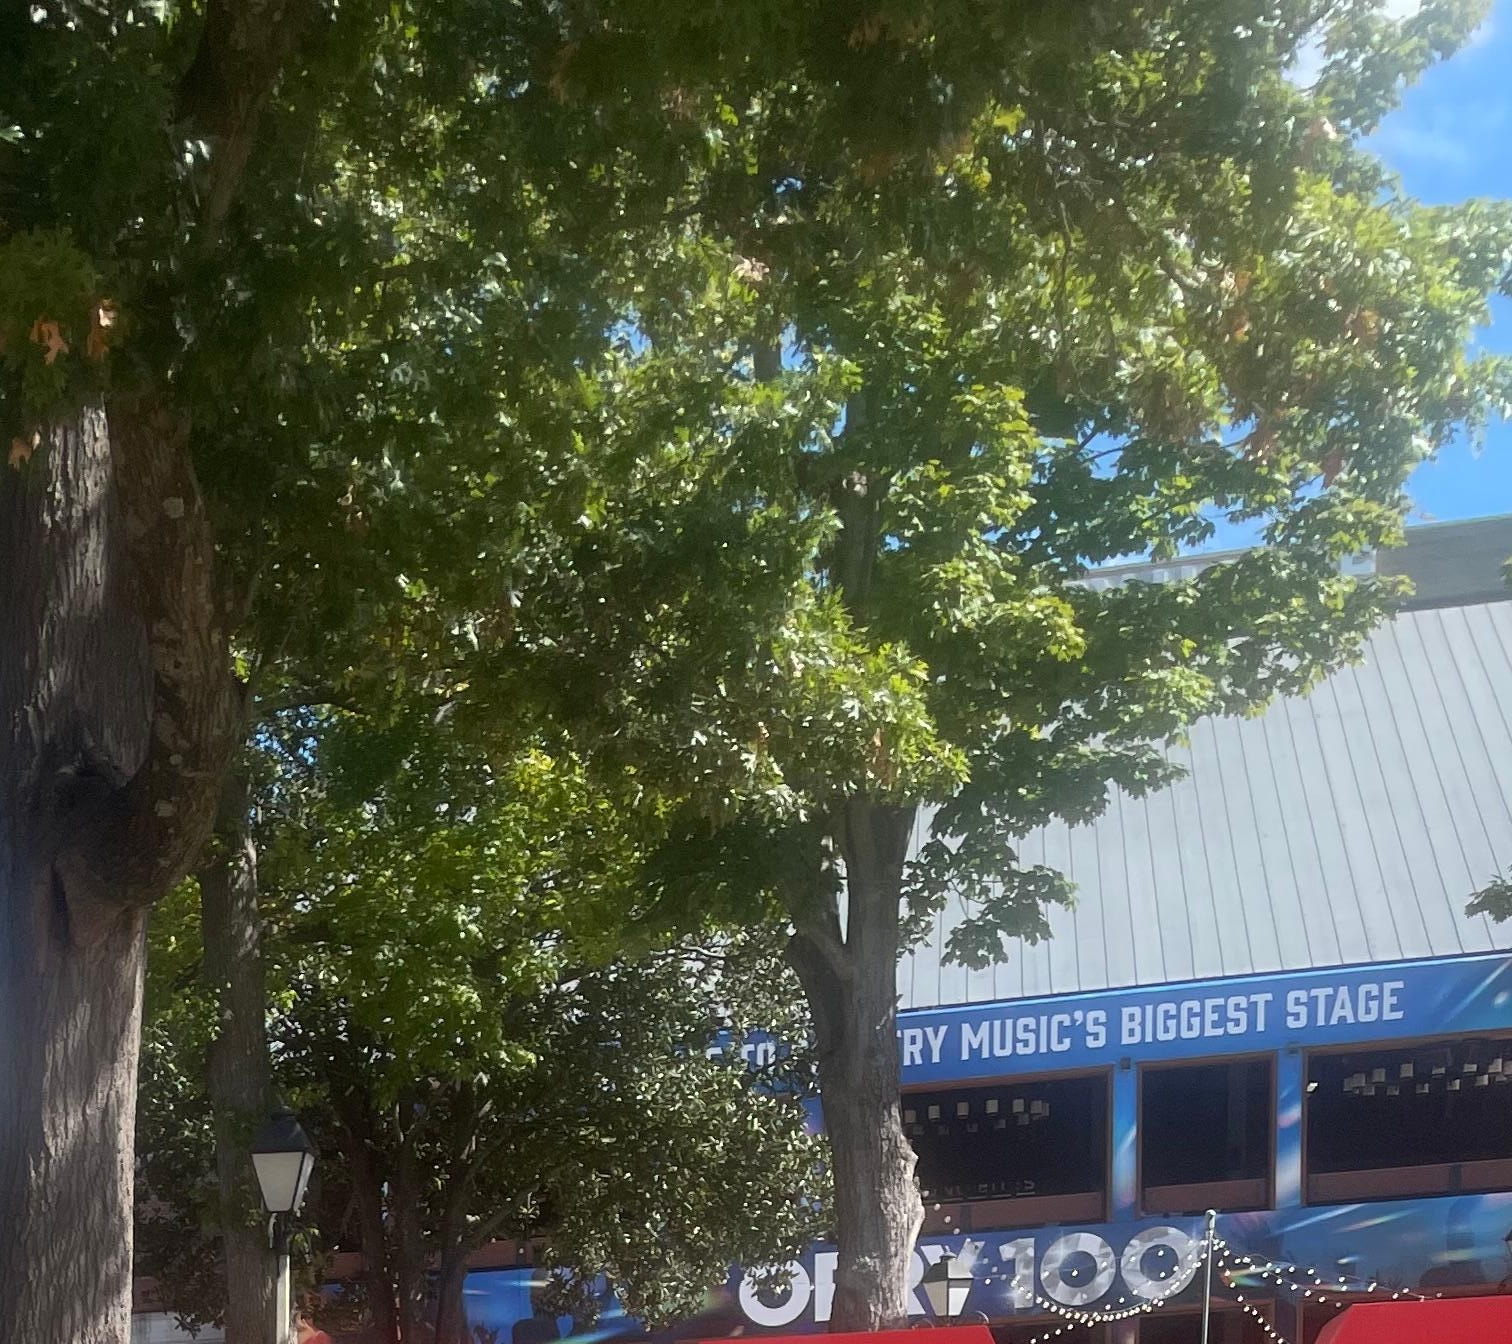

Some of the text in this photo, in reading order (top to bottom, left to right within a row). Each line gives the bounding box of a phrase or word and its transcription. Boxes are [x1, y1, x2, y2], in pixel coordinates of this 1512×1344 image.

[960, 1008, 1106, 1061] MUSIC'S
[1121, 992, 1274, 1046] BIGGEST
[1285, 981, 1405, 1030] STAGE
[1000, 1225, 1196, 1309] 100
